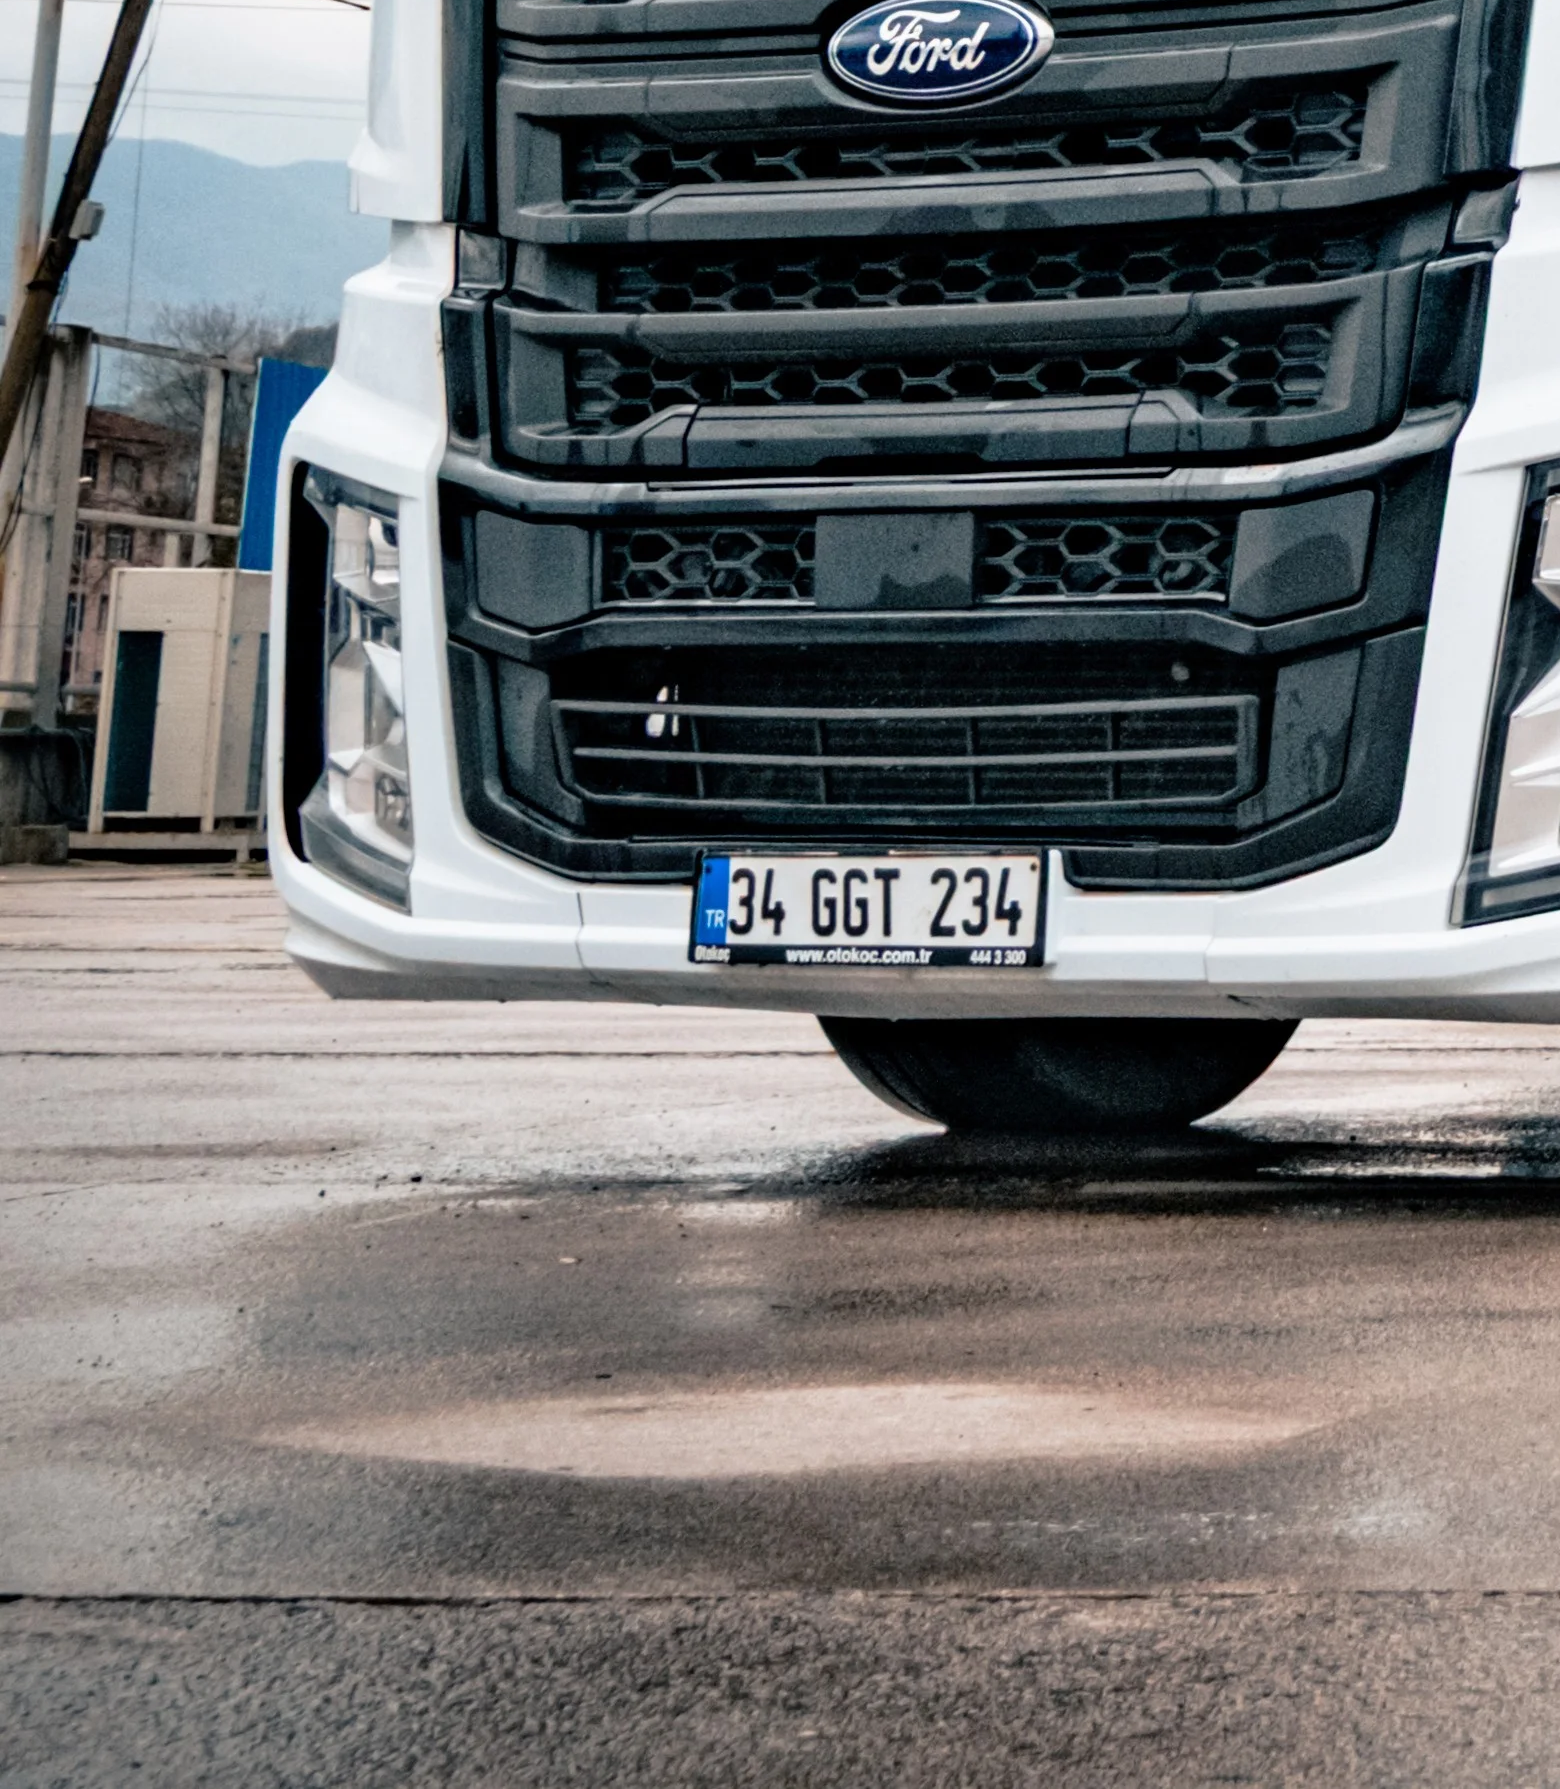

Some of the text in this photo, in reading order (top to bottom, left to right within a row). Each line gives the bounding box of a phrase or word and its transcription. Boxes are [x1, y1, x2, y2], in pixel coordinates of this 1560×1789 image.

[867, 9, 990, 76] Ford
[729, 867, 1022, 937] 34 GGT 234
[705, 909, 726, 928] TR
[785, 948, 933, 964] www.otokoc.com.tr
[969, 949, 1026, 965] 444 3 300
